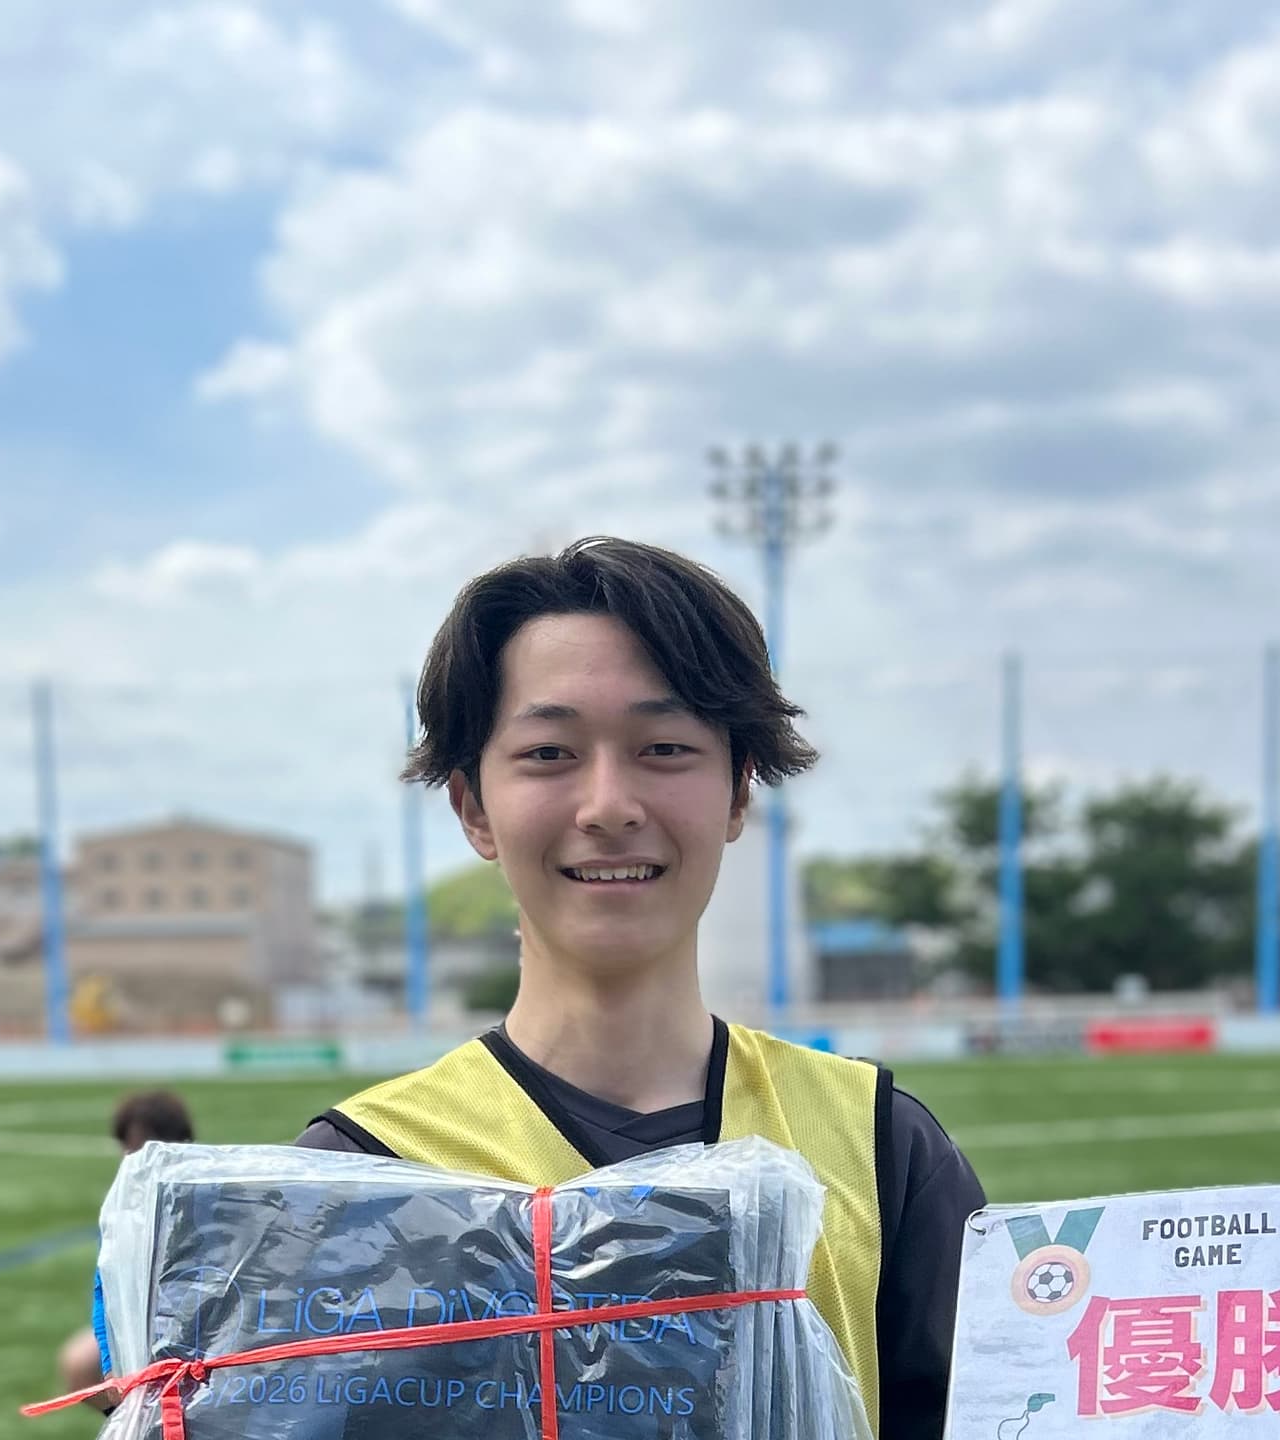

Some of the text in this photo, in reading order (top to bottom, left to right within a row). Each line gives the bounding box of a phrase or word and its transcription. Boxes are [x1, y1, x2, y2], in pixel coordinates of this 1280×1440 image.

[1142, 1212, 1277, 1241] FOOTBALL
[1174, 1243, 1242, 1268] GAME
[474, 1379, 696, 1416] CHAMPIONS
